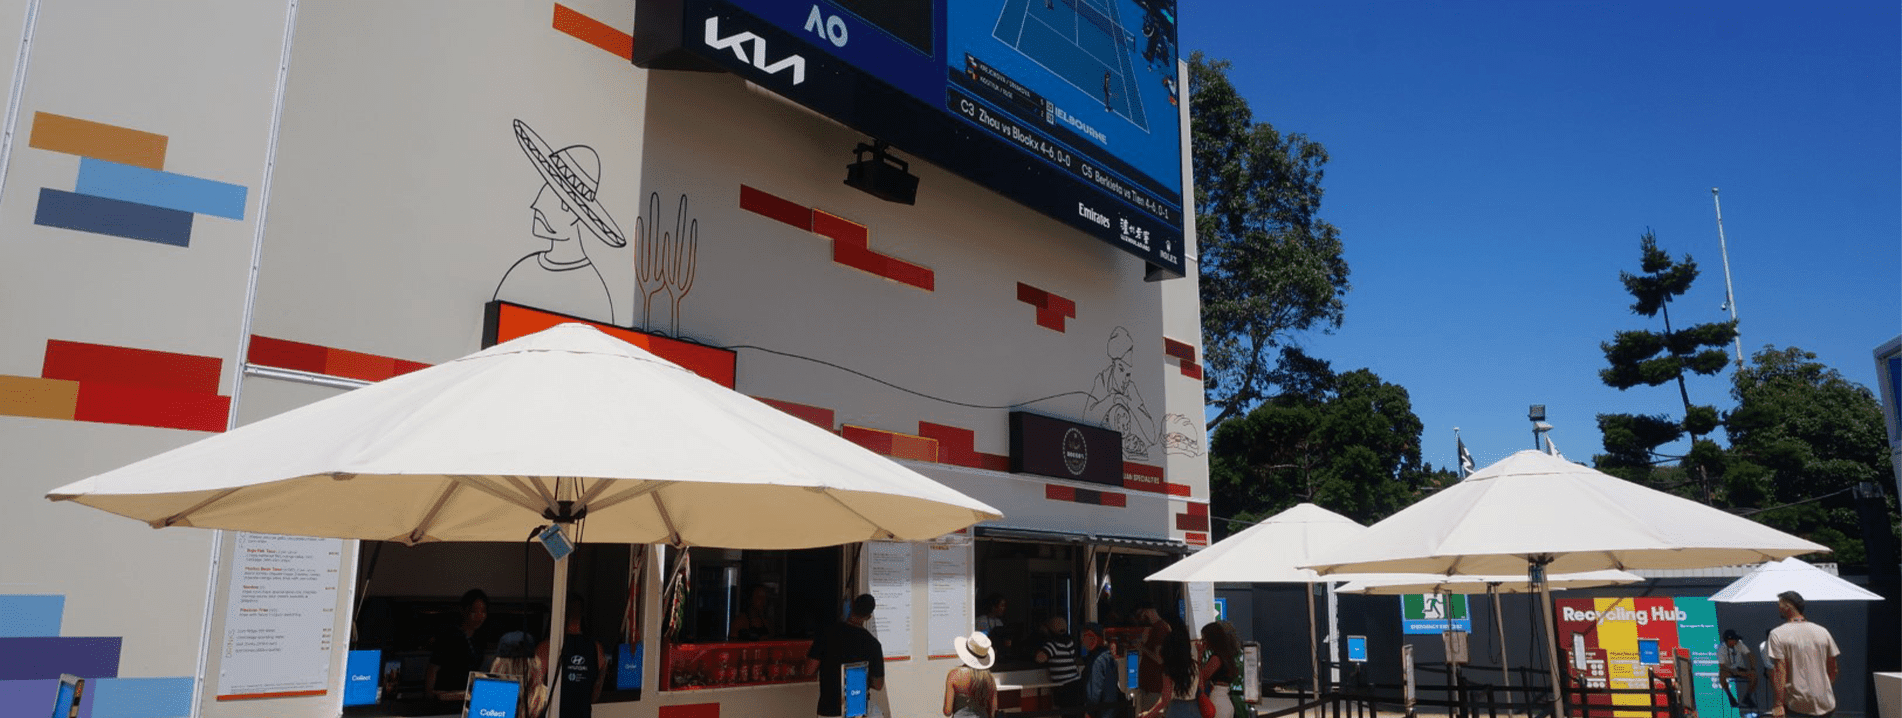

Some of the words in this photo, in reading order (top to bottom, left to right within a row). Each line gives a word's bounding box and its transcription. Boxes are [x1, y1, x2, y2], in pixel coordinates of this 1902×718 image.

[960, 99, 975, 117] C3
[979, 108, 1000, 130] Zhou
[1001, 123, 1011, 136] vs
[1012, 125, 1039, 151] Blockx
[1057, 150, 1071, 167] 0-0
[1081, 163, 1093, 179] C5
[1123, 188, 1132, 200] vs
[1078, 201, 1111, 229] Emirates
[1160, 249, 1178, 265] ROLEX
[1562, 606, 1649, 625] Recycling
[1651, 605, 1687, 621] Hub
[352, 673, 372, 682] Collect
[480, 708, 507, 717] Collect
